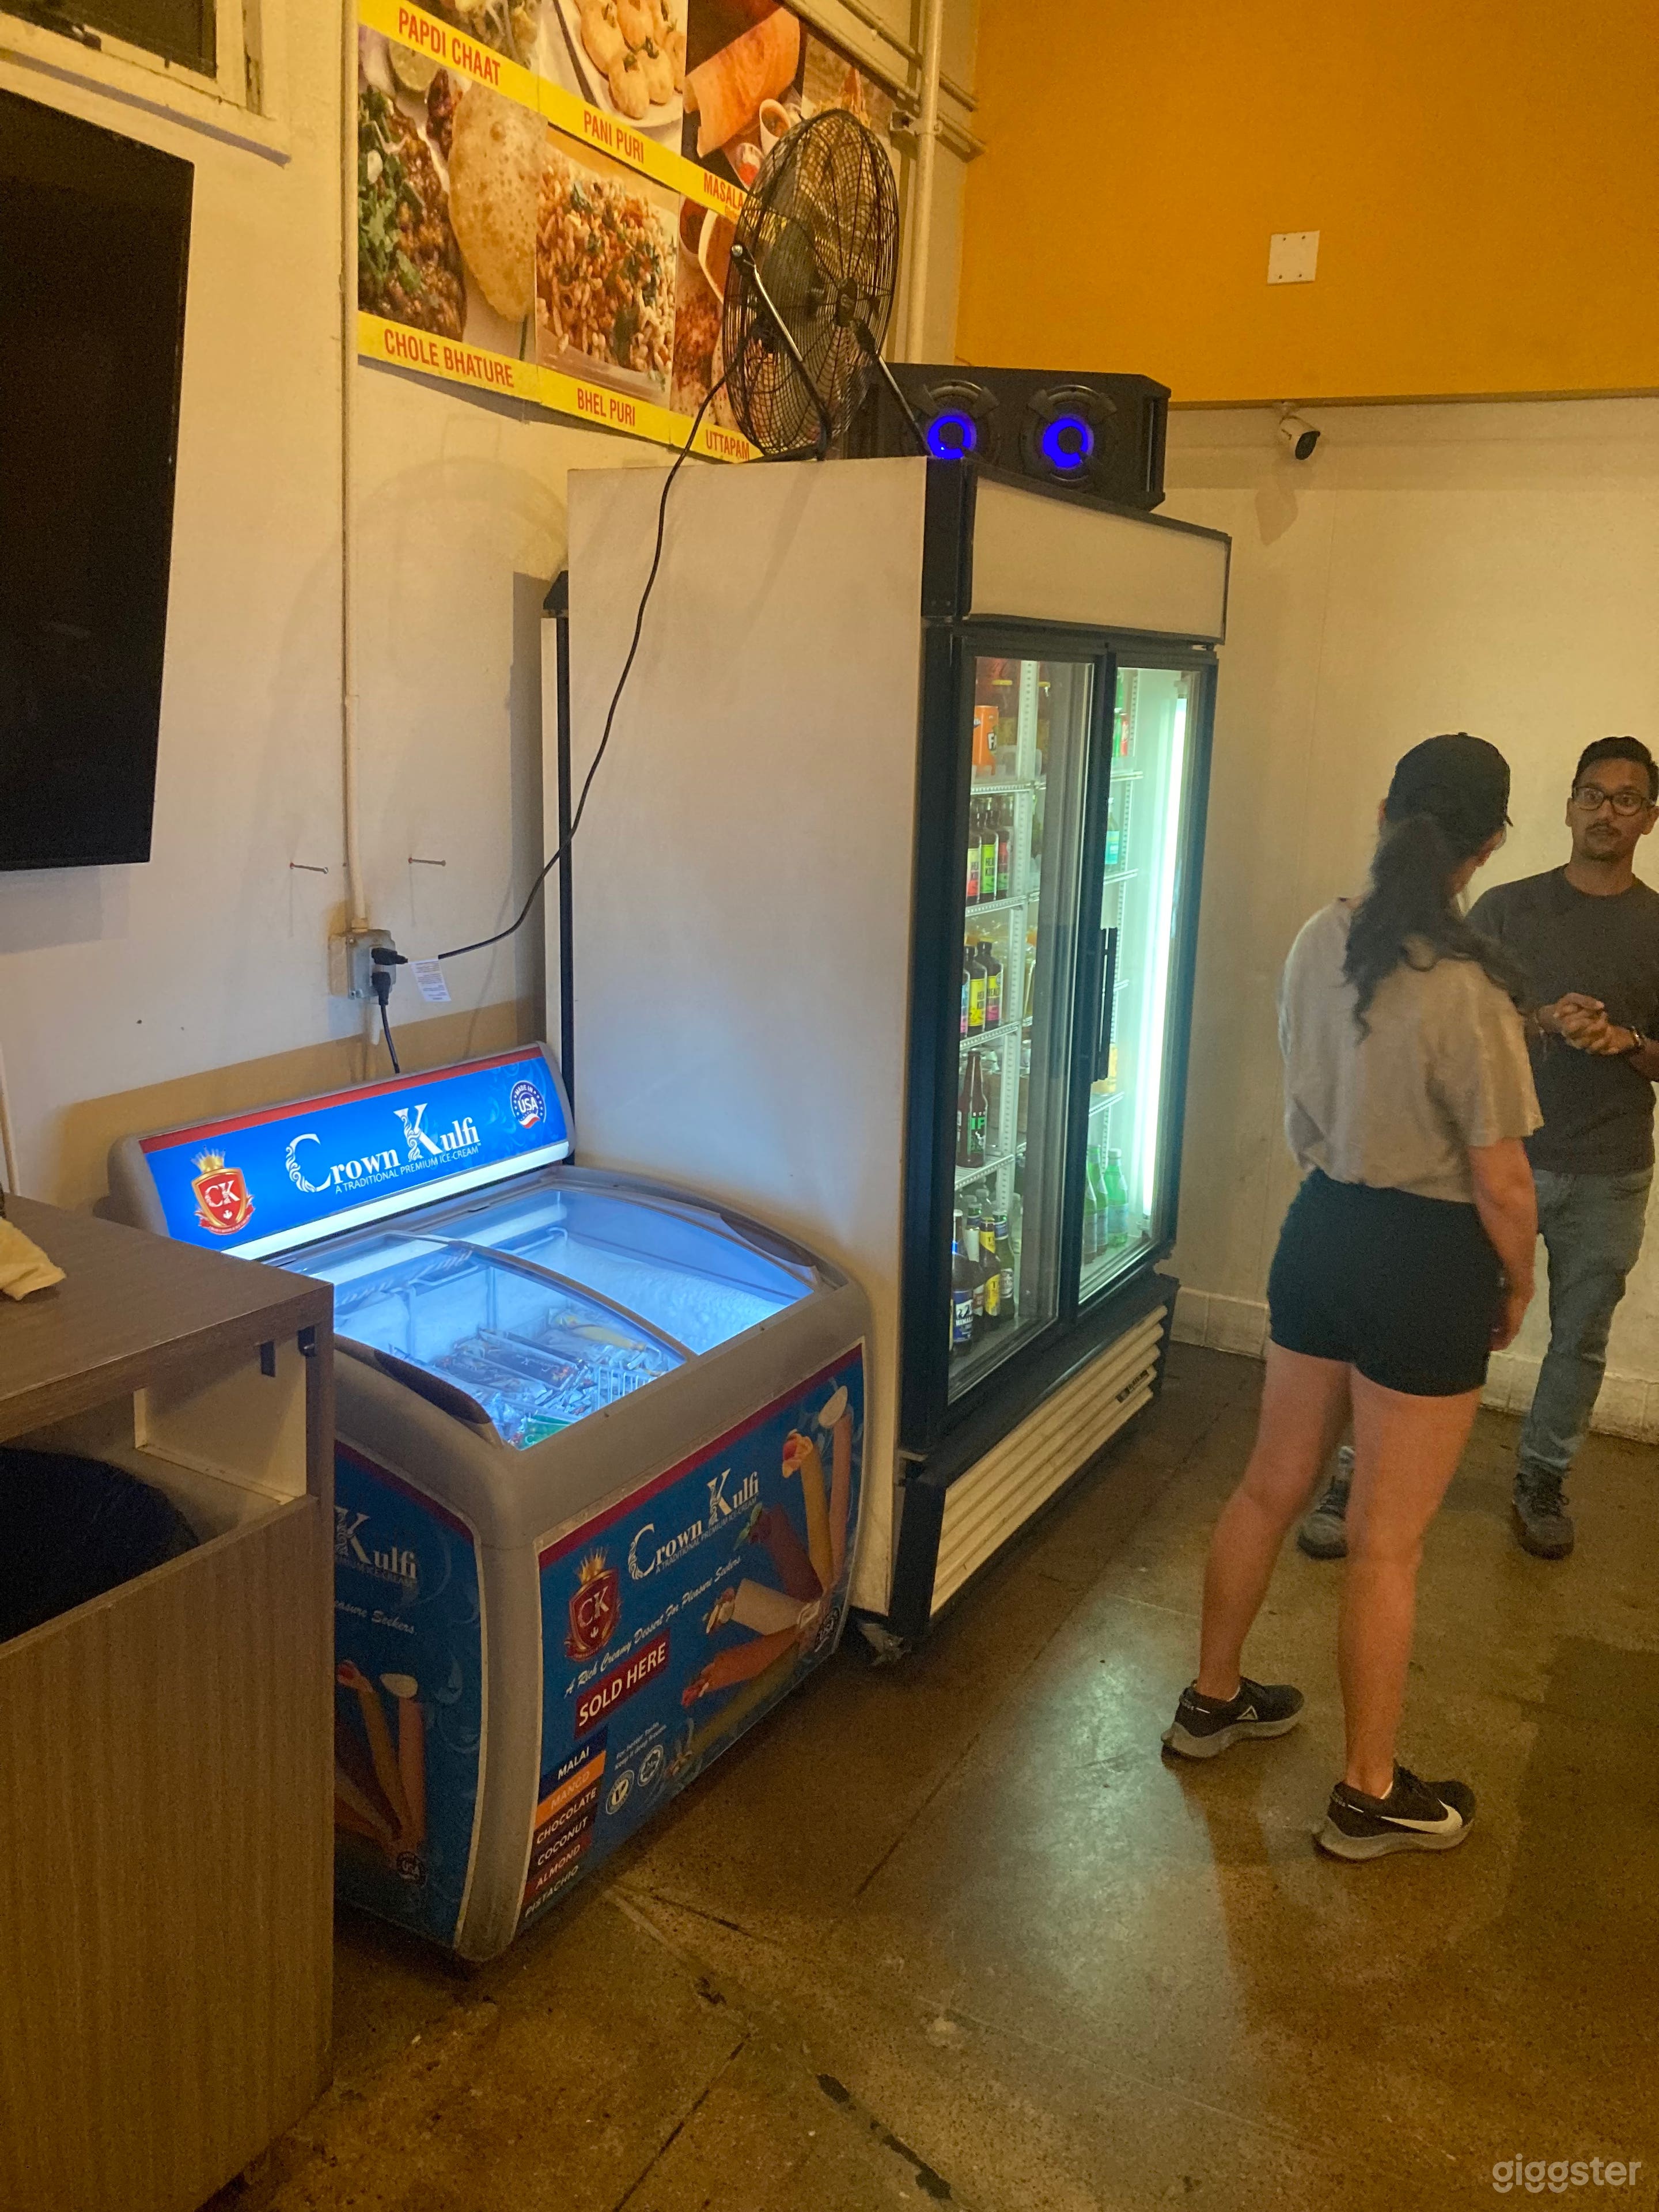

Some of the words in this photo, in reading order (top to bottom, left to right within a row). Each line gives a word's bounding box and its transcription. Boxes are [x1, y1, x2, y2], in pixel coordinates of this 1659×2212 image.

[399, 7, 446, 58] PAPDI
[452, 37, 501, 86] CHAAT
[584, 110, 612, 147] PANI
[616, 127, 644, 164] PURI
[704, 172, 743, 210] MASALA
[384, 328, 440, 367] CHOLE
[444, 346, 514, 388] BHATURE
[577, 388, 607, 417] BHEL
[610, 398, 635, 426] PURI
[706, 429, 749, 460] UTTAPAM
[515, 1085, 527, 1096] MADE
[518, 1096, 539, 1113] USA
[285, 1133, 401, 1192] Crown
[393, 1103, 480, 1162] Kulfi
[204, 1180, 240, 1207] CK
[335, 1184, 343, 1194] A
[343, 1169, 399, 1192] TRADITIONAL
[400, 1158, 438, 1175] PREMIUM
[334, 1505, 416, 1579] Kulfi
[628, 1520, 702, 1580] Crown
[707, 1468, 759, 1528] Kulfi
[656, 1564, 660, 1575] A
[662, 1538, 700, 1569] TRADITIONAL
[701, 1517, 728, 1542] PREMIUM
[578, 1586, 609, 1627] CK
[565, 1677, 575, 1699] A
[578, 1661, 597, 1688] Rich
[600, 1641, 632, 1672] Creamy
[634, 1615, 664, 1644] Dessert
[665, 1604, 679, 1622] For
[682, 1578, 713, 1608] Pleasure
[579, 1678, 623, 1727] SOLD
[627, 1642, 666, 1689] HERE
[558, 1746, 589, 1780] MALAI
[551, 1771, 590, 1810] MANGO
[537, 1787, 597, 1844] CHOCOLATE
[537, 1816, 588, 1866] COCONUT
[536, 1844, 581, 1890] ALMOND
